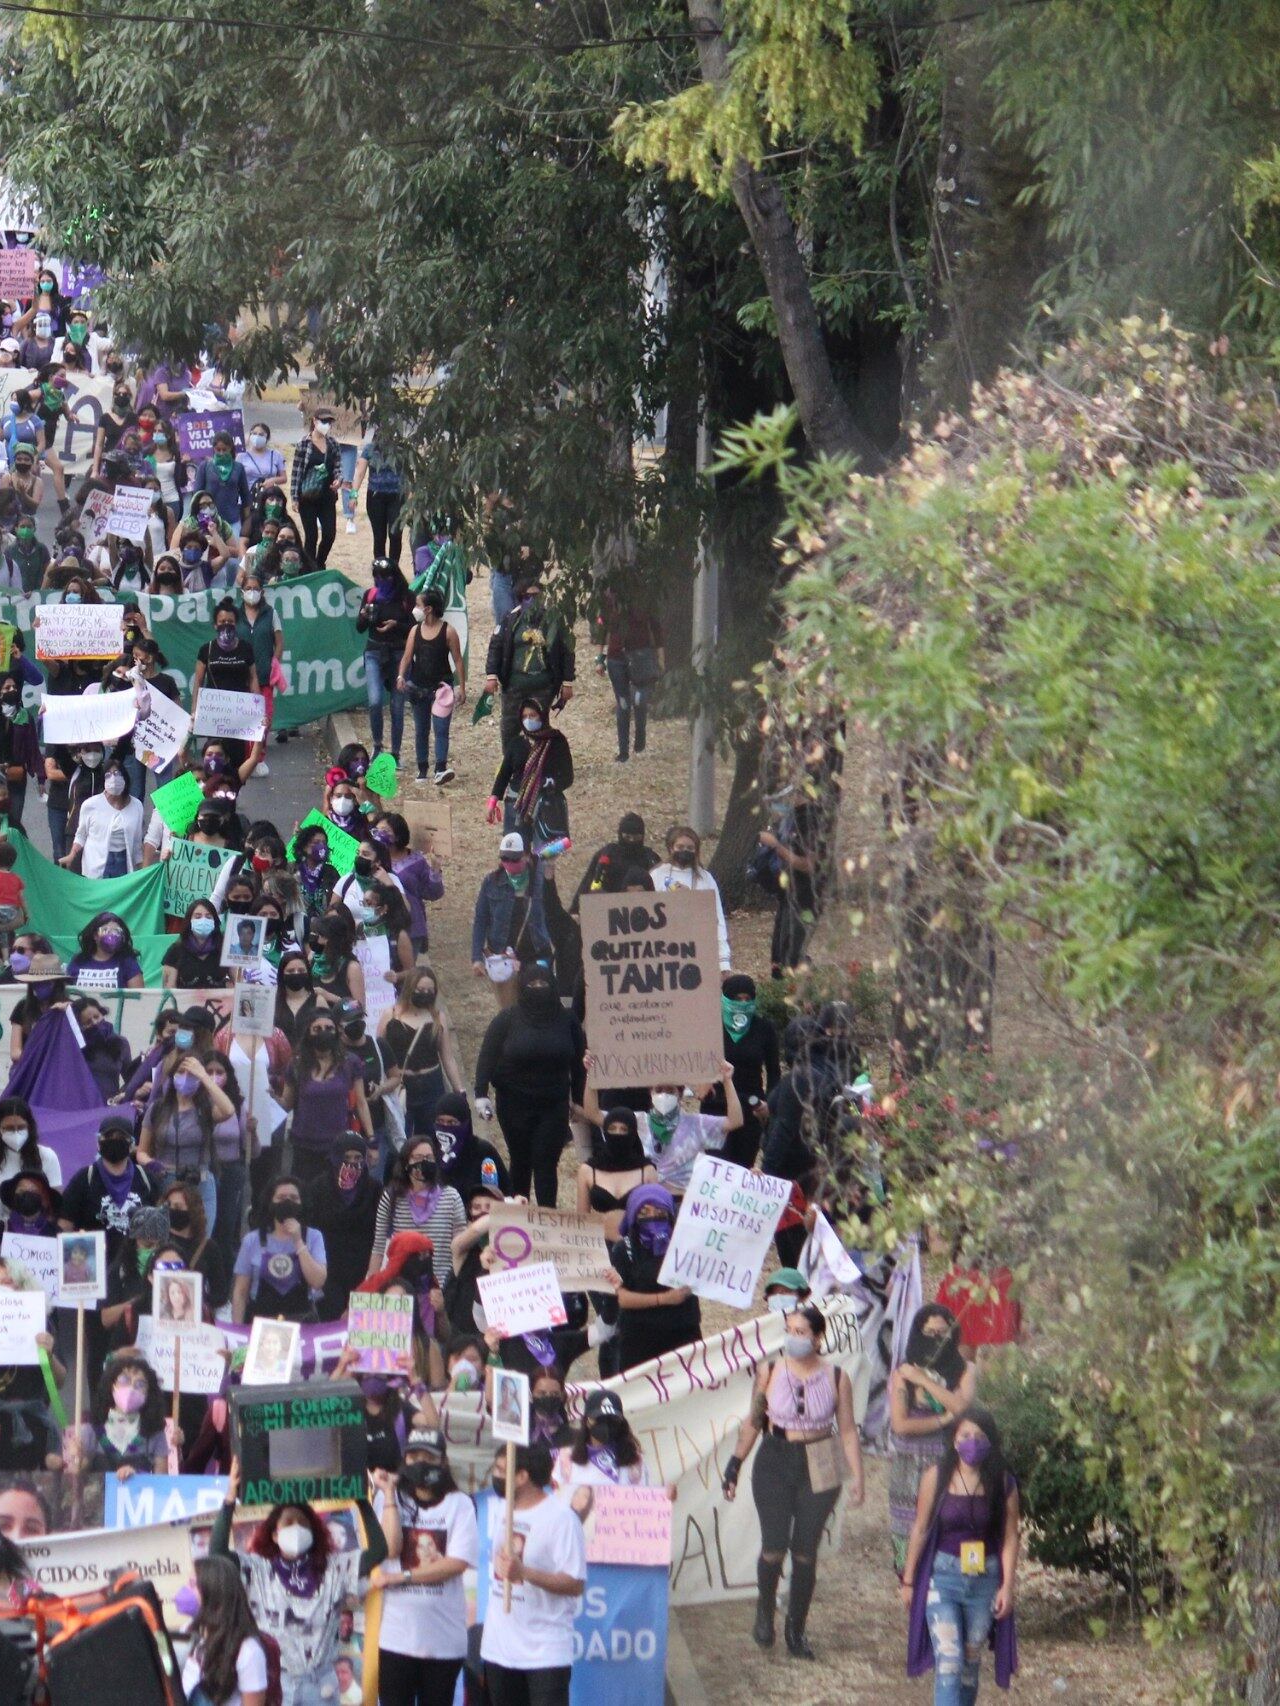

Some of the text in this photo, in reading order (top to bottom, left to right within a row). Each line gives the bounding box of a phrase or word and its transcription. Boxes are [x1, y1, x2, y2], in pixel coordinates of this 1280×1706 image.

[186, 420, 213, 431] 3DE3
[189, 429, 215, 440] VS LA
[171, 840, 195, 863] UN
[607, 902, 668, 936] NOS
[590, 939, 696, 962] QUITARON
[599, 961, 703, 996] TANTO
[614, 1027, 673, 1042] el miedo
[708, 1160, 786, 1200] TE CANSAS
[699, 1180, 780, 1221] DE OIRLO?
[690, 1201, 764, 1234] NOSOTRAS
[532, 1229, 606, 1248] DE SUERTE
[705, 1228, 729, 1252] DE
[577, 1252, 594, 1265] ES
[674, 1247, 753, 1294] VIVIRLO
[263, 1396, 353, 1417] MI CUERPO
[243, 1475, 367, 1506] ABORTO LEGAL
